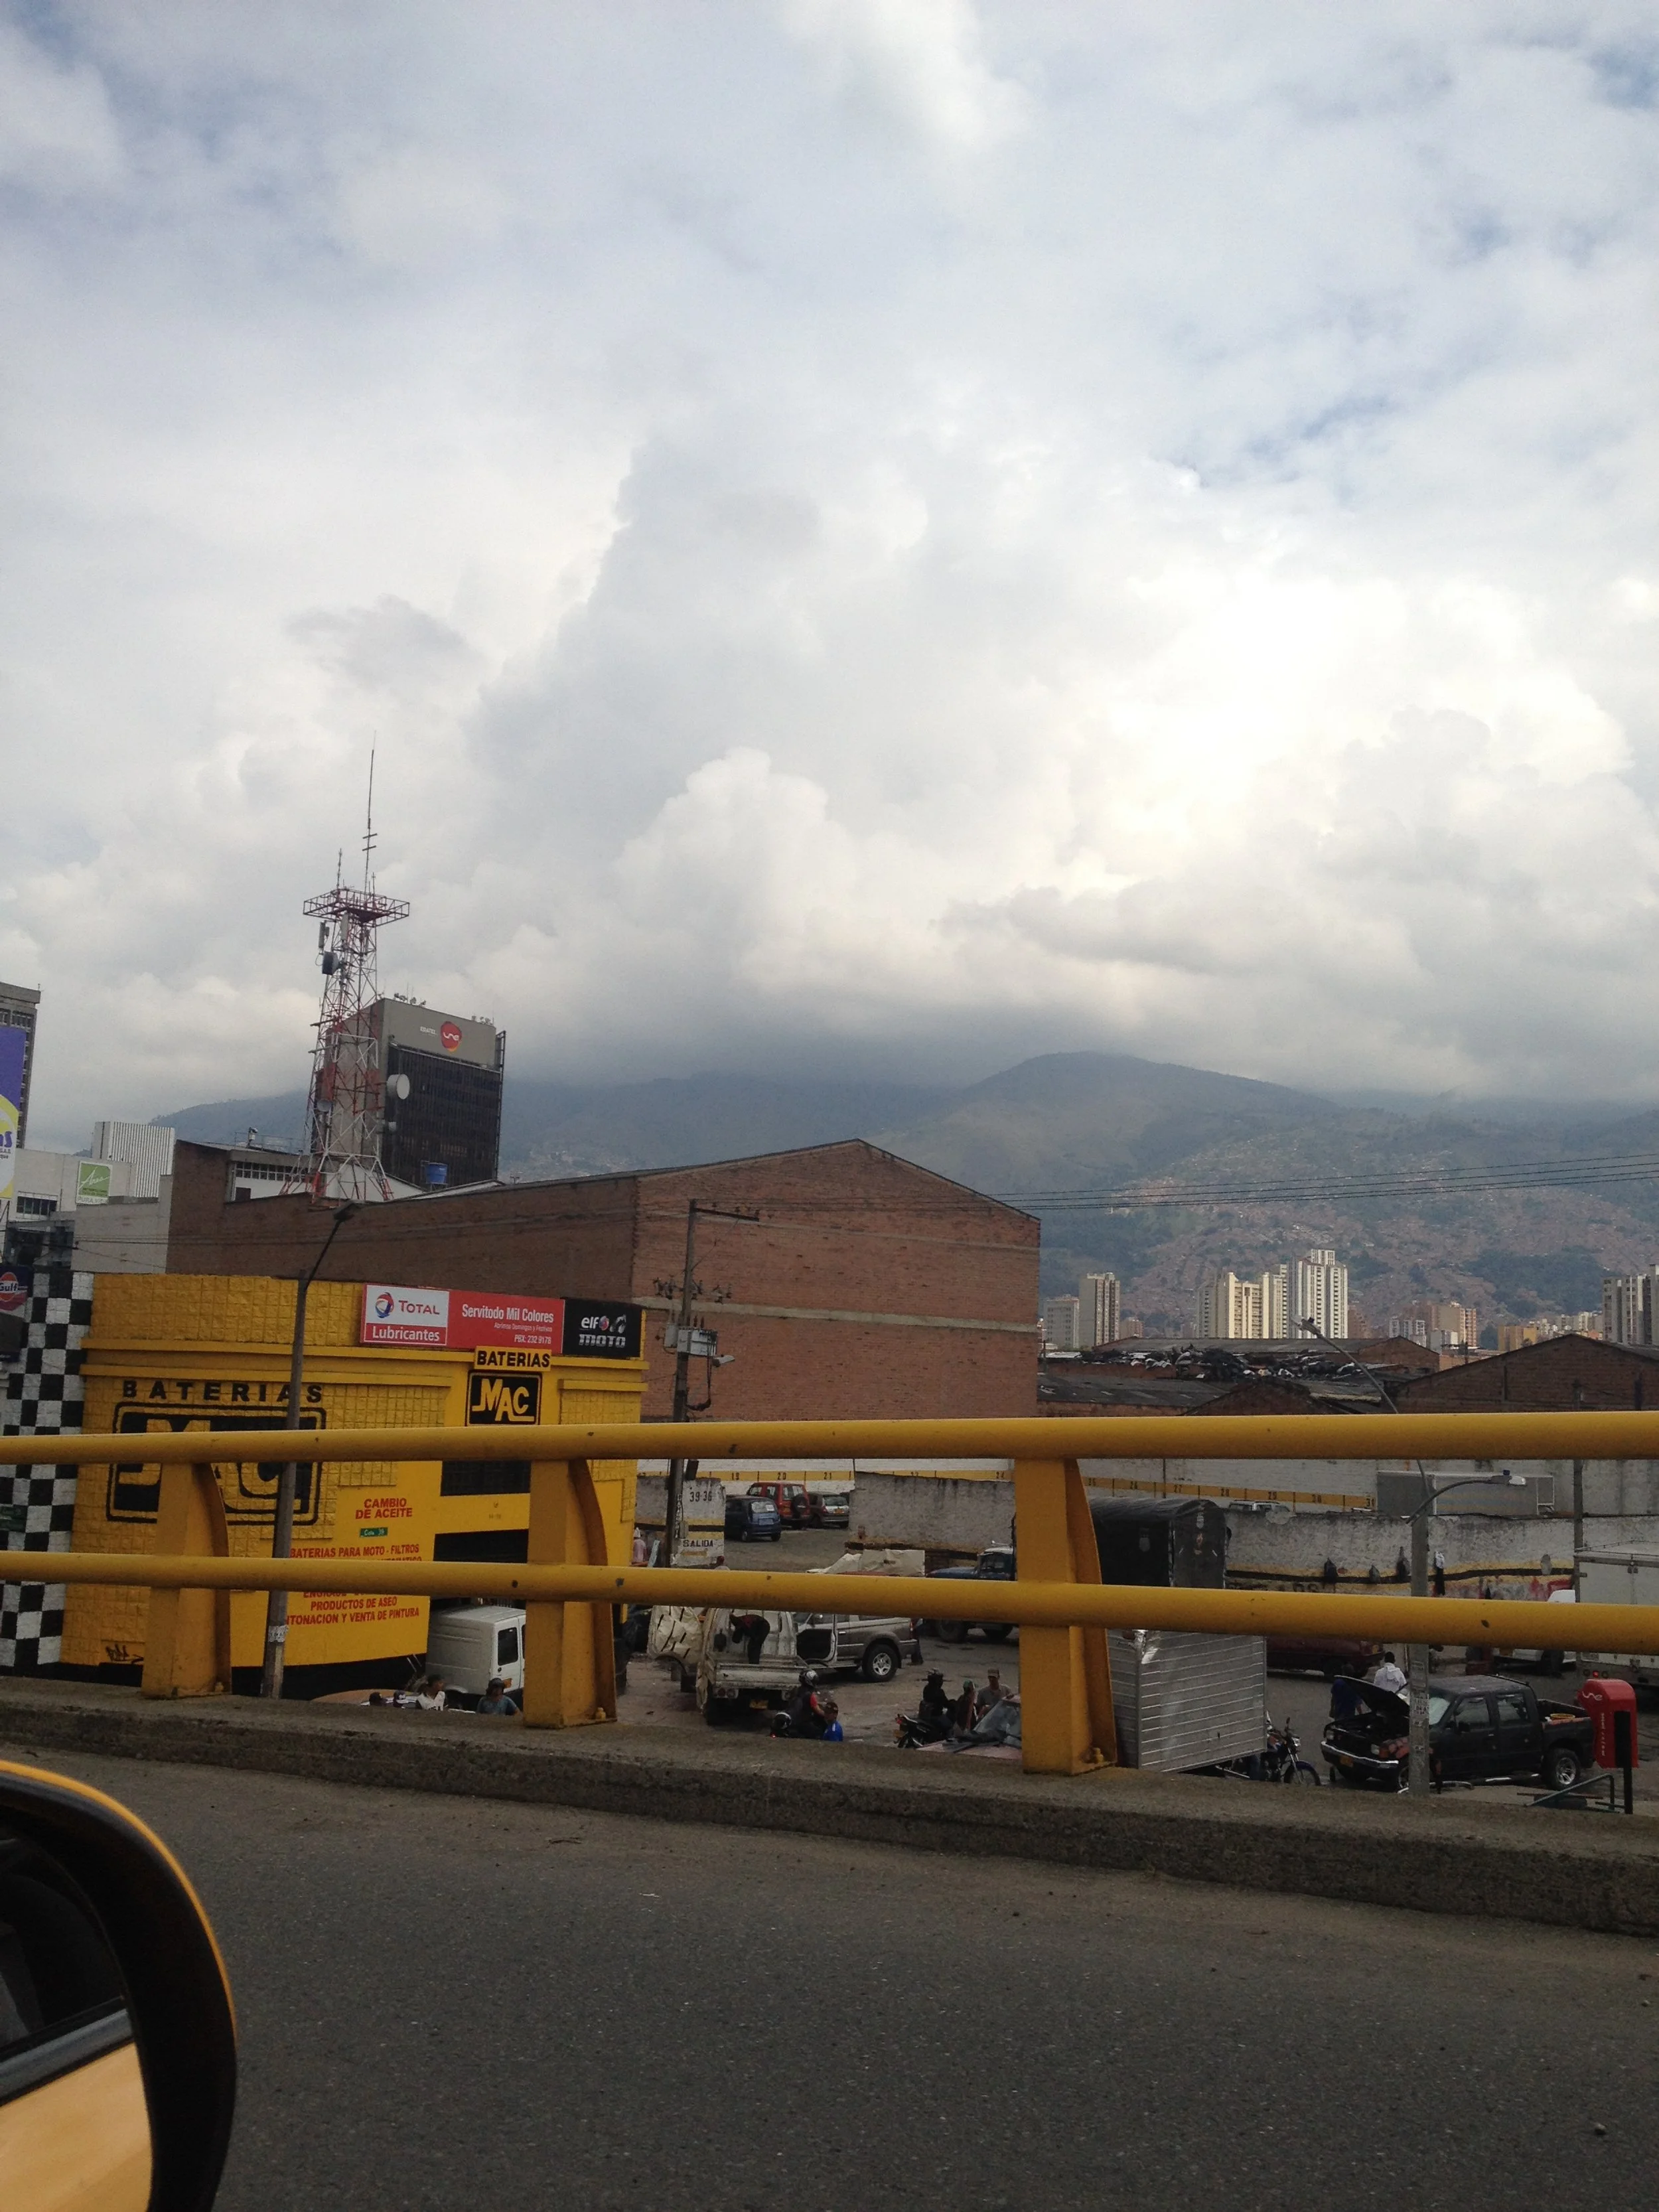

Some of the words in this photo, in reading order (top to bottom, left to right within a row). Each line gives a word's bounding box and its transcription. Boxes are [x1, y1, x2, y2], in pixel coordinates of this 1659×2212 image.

[443, 1031, 460, 1041] une
[0, 1283, 18, 1292] Gulf
[398, 1299, 440, 1315] TOTAL
[462, 1303, 504, 1320] Servitodo
[506, 1307, 520, 1321] Mil
[522, 1308, 554, 1323] Colores
[581, 1316, 600, 1330] elf
[372, 1325, 440, 1341] Lubricantes
[514, 1334, 526, 1343] PBX:
[527, 1335, 538, 1344] 232
[476, 1350, 551, 1368] BATERIAS
[123, 1380, 322, 1403] BATERIAS
[471, 1378, 535, 1422] MAC
[363, 1497, 407, 1509] CAMBIO
[355, 1509, 372, 1520] DE
[374, 1507, 413, 1518] ACEITE
[683, 1539, 714, 1548] SALIDA
[290, 1547, 336, 1558] BATERIAS
[338, 1546, 361, 1557] PARA
[363, 1546, 385, 1556] MOTO
[391, 1544, 419, 1554] FILTROS
[311, 1599, 364, 1611] PRODUCTOS
[366, 1598, 376, 1609] DE
[378, 1595, 397, 1607] ASEO
[342, 1613, 347, 1623] Y
[350, 1611, 375, 1623] VENTA
[378, 1610, 387, 1621] DE
[389, 1607, 419, 1619] PINTURA
[1582, 1690, 1603, 1701] une
